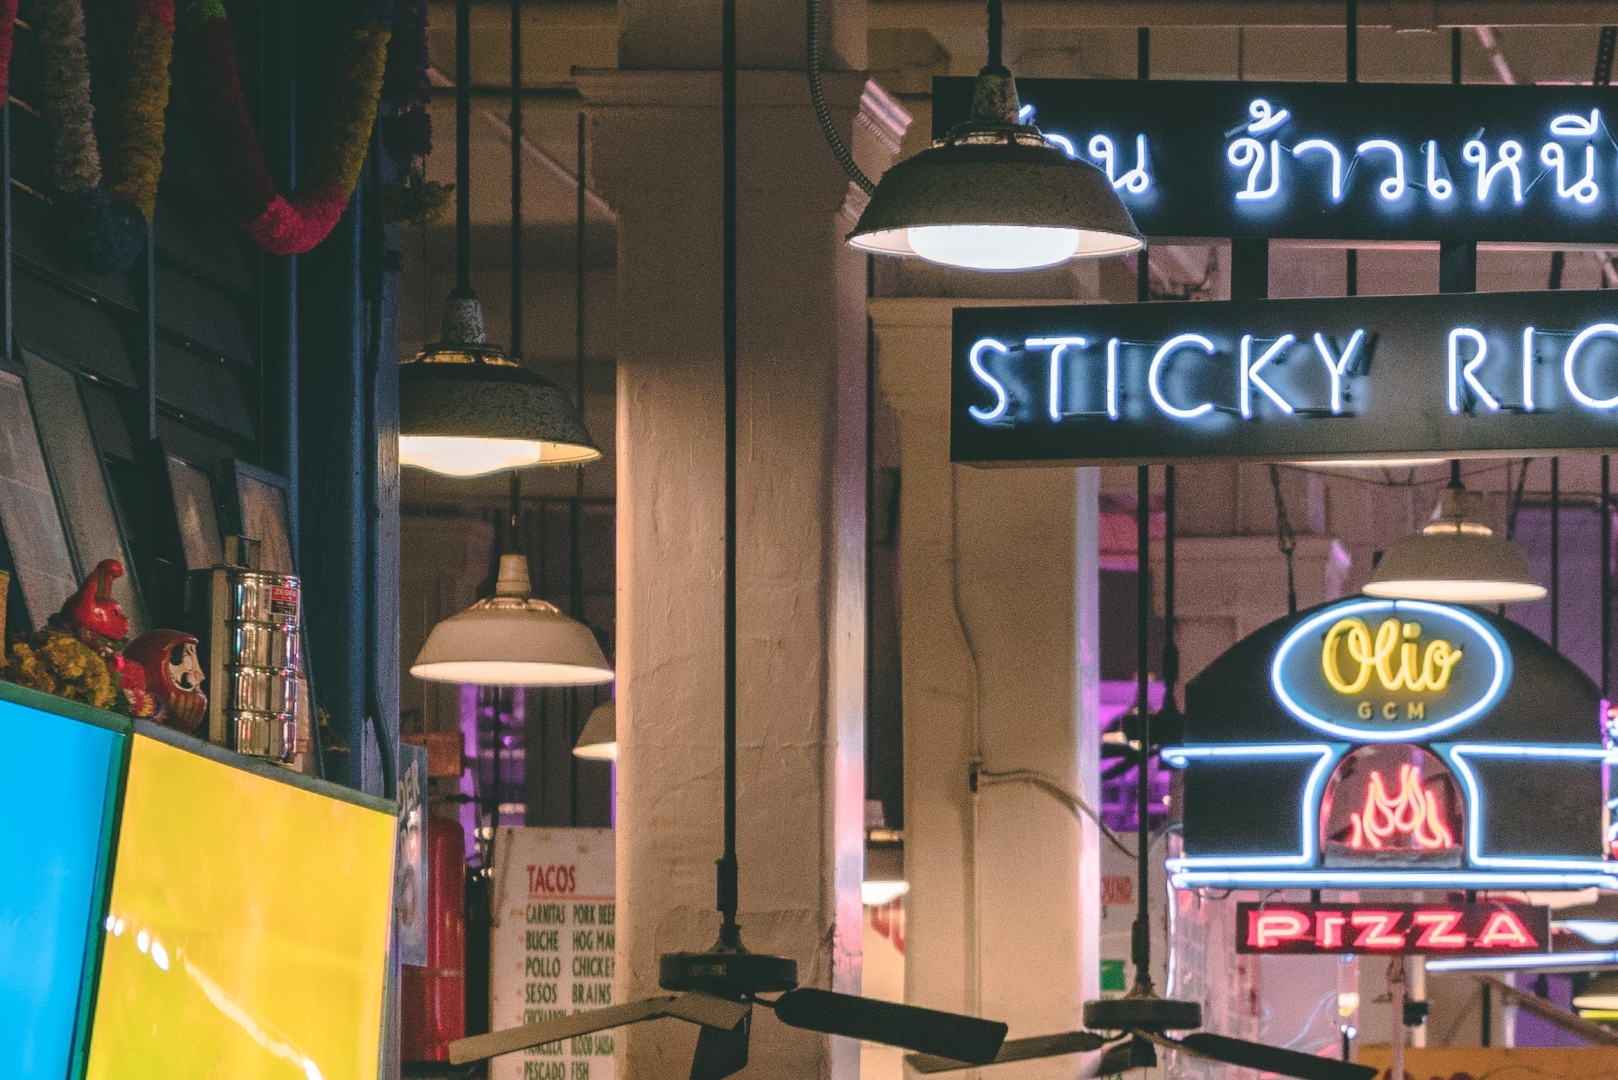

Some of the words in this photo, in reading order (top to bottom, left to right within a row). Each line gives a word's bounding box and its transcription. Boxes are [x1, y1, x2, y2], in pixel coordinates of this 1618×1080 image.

[966, 328, 1367, 422] STICKY
[1321, 616, 1463, 695] Olio
[527, 864, 576, 893] TACOS
[526, 904, 566, 924] CARNITAS
[573, 904, 595, 925] PORK
[526, 930, 559, 951] BUCHE
[572, 930, 593, 951] HOG
[1246, 908, 1539, 949] PIZZA
[525, 956, 561, 978] POLLO
[525, 983, 558, 1004] SESOS
[571, 983, 612, 1004] BRAINS
